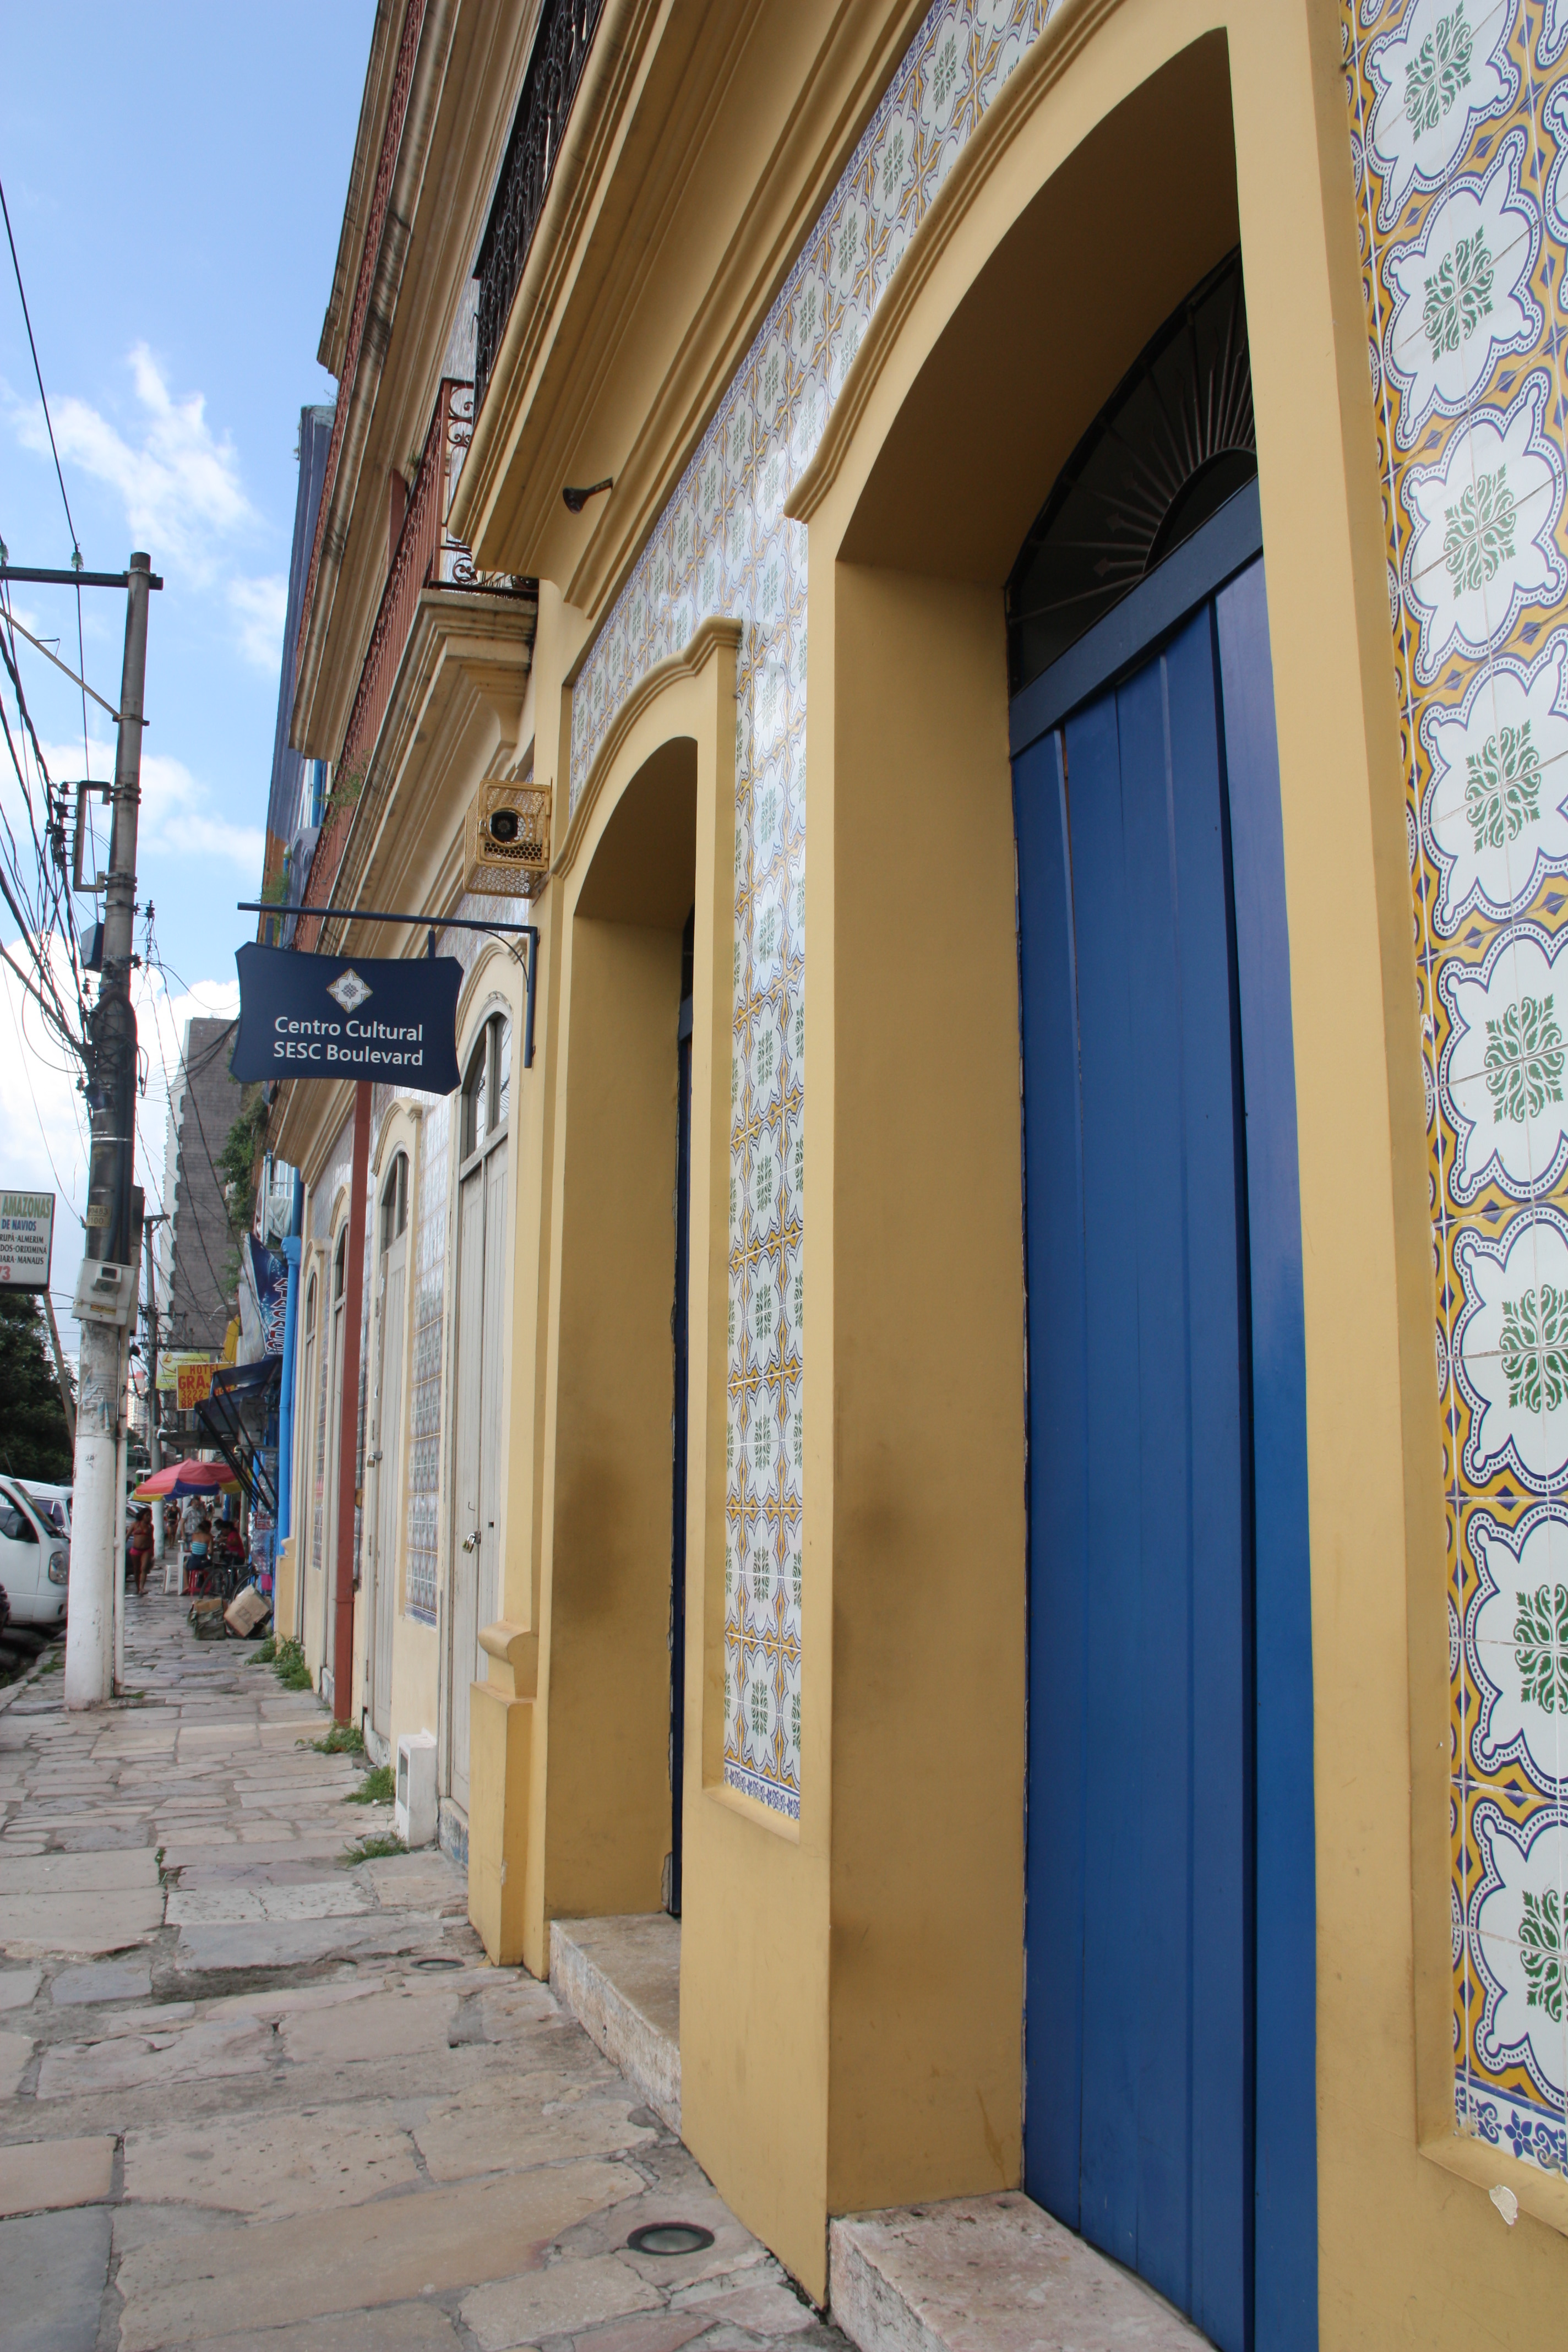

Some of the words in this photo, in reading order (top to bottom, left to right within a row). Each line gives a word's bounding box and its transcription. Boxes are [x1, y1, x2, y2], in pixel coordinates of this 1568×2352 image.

[275, 1016, 341, 1036] Centro
[346, 1020, 423, 1042] Cultural
[274, 1041, 322, 1060] SESC
[327, 1044, 423, 1066] Boulevard
[2, 1196, 51, 1218] AMAZONAS
[2, 1219, 10, 1230] DE
[12, 1219, 36, 1232] NAVIOS
